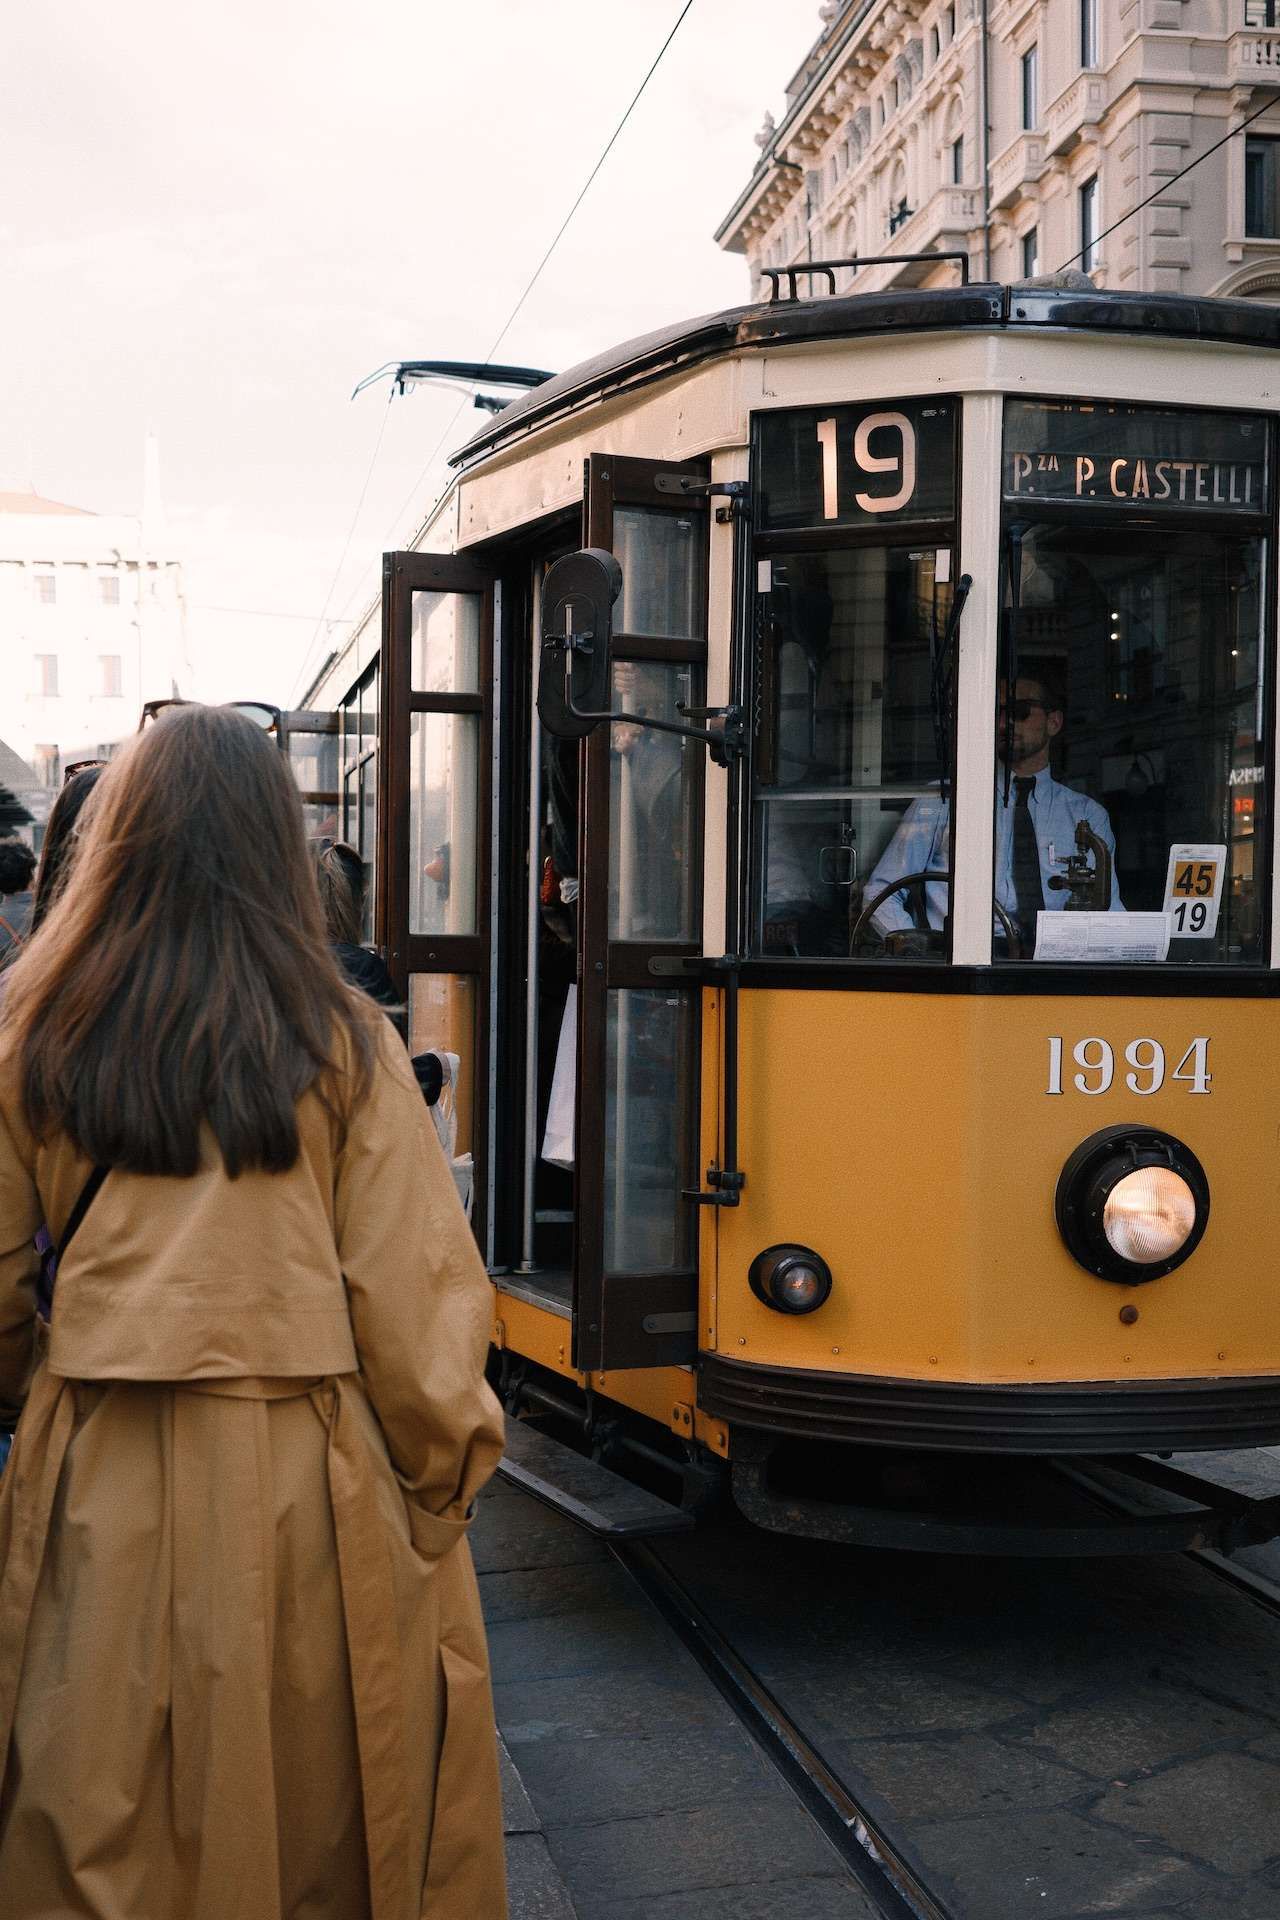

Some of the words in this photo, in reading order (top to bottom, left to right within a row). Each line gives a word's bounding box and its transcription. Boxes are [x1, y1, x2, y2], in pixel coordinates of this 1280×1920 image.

[816, 411, 916, 520] 19
[1075, 456, 1097, 497] P.
[1109, 459, 1252, 504] CASTELLI
[1176, 864, 1213, 896] 45
[1174, 902, 1207, 932] 19
[1045, 1036, 1212, 1095] 1994
